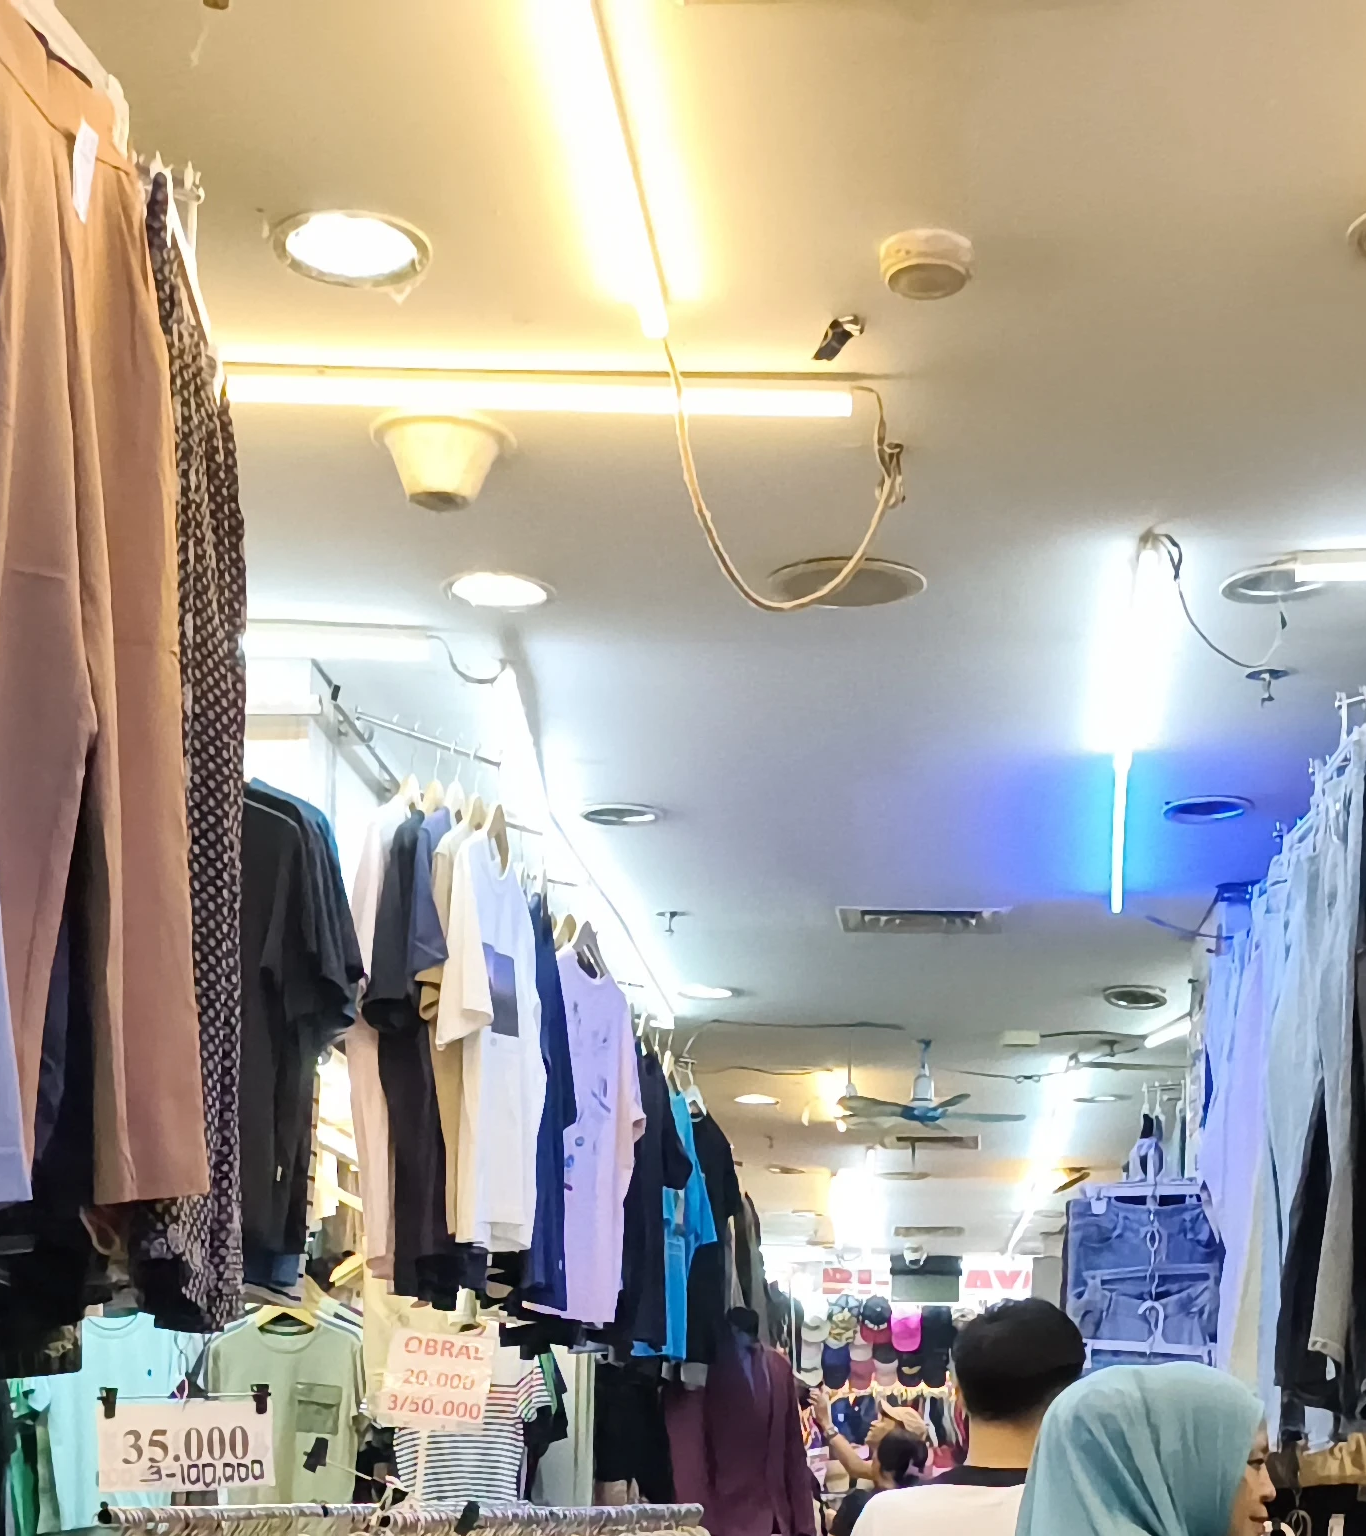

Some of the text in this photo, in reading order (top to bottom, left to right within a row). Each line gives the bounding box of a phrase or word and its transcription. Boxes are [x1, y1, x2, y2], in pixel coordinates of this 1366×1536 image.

[404, 1336, 484, 1361] OBRAL
[403, 1367, 475, 1391] 20.000
[387, 1394, 481, 1420] 3/50.000
[121, 1425, 250, 1465] 35.000
